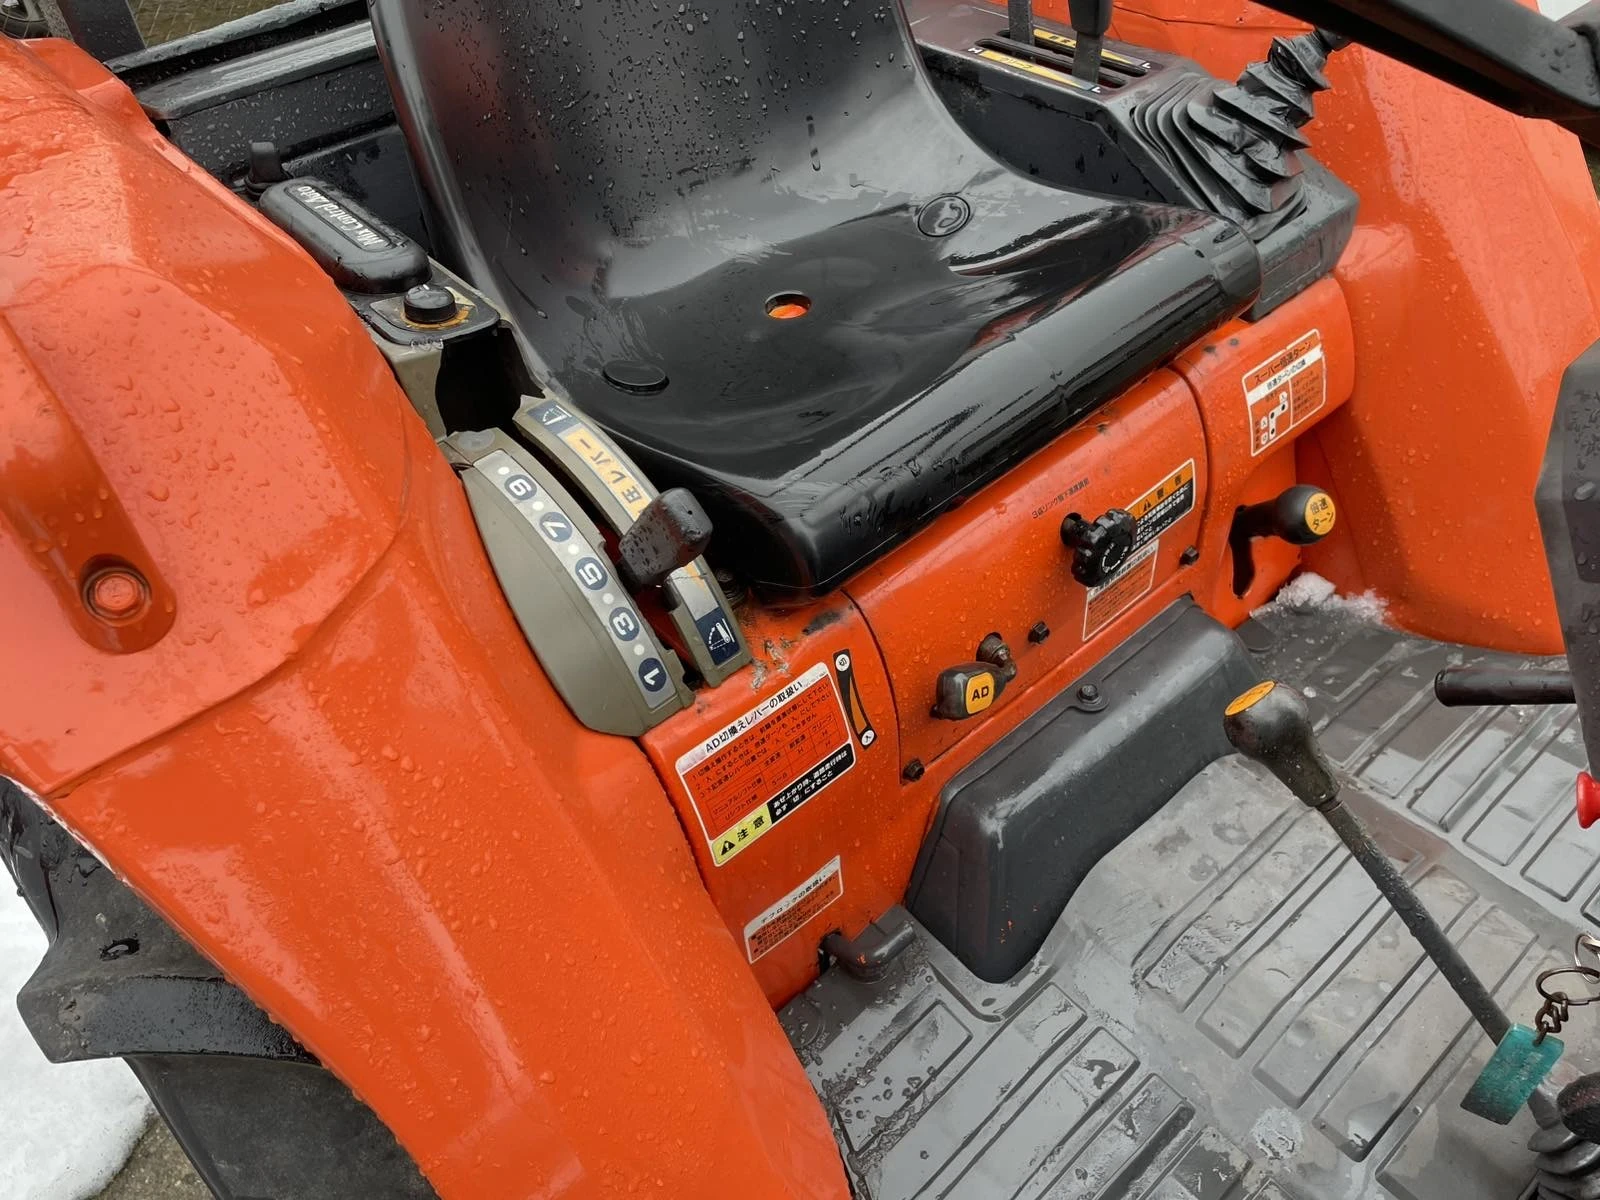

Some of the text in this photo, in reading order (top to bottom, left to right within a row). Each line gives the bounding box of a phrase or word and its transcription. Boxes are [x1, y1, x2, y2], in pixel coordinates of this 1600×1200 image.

[297, 185, 385, 246] Mix Control Auto
[578, 438, 644, 511] 圧レバー
[1310, 497, 1329, 514] 倍速
[543, 520, 568, 538] 7
[1313, 512, 1334, 530] ターン
[579, 561, 602, 585] 5
[613, 614, 635, 636] 3
[643, 668, 664, 686] 1
[971, 685, 989, 701] AD
[735, 814, 765, 842] 注意
